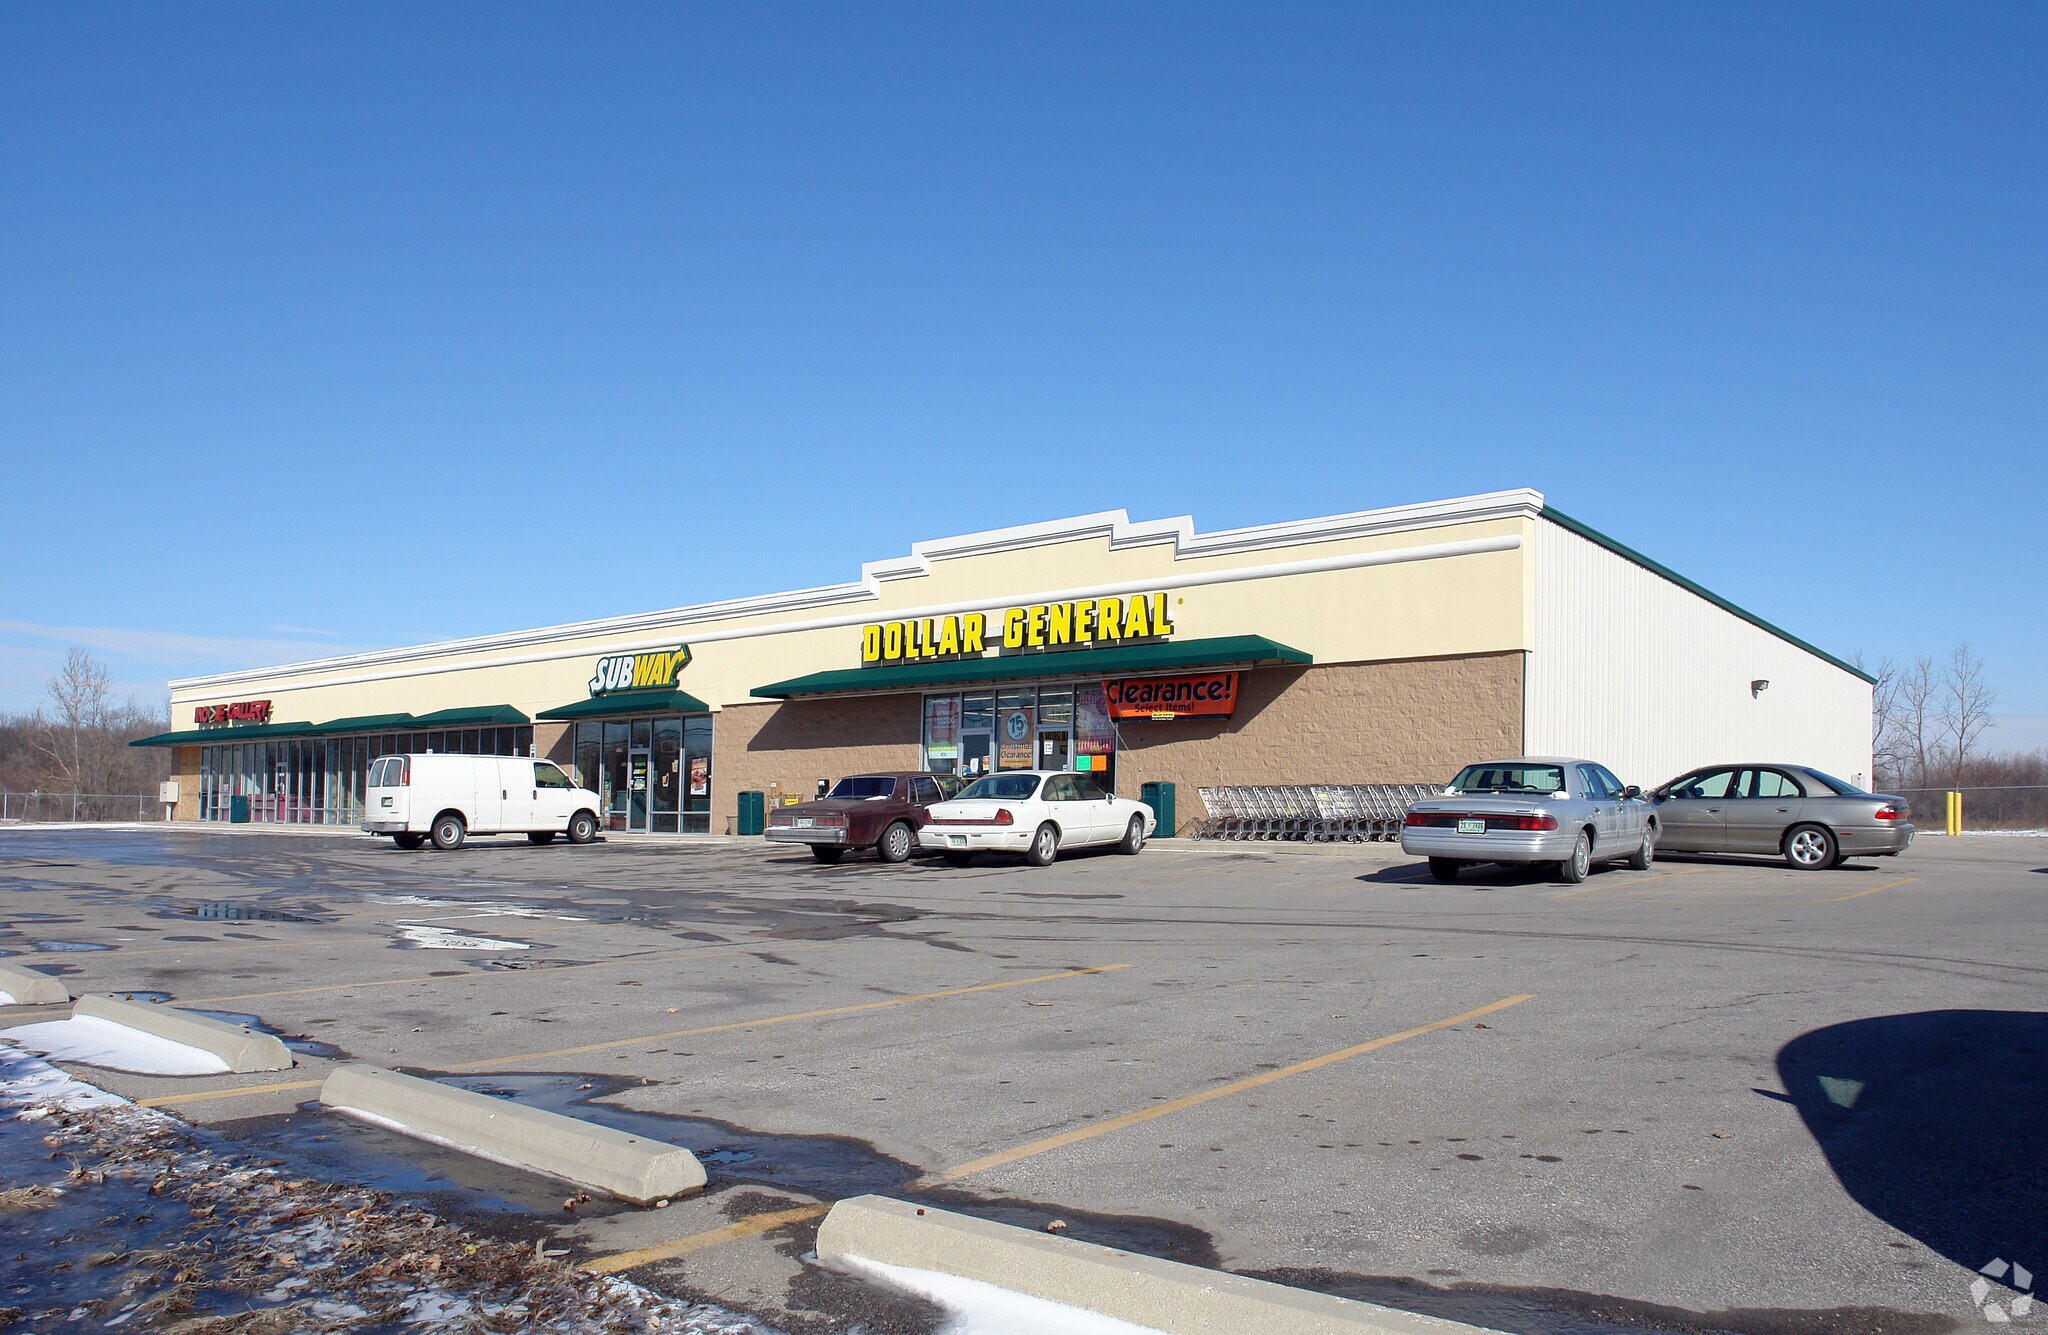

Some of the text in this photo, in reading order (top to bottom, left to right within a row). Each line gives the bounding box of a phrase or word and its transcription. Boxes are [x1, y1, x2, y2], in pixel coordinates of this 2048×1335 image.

[863, 592, 1171, 662] DOLLAR GENERAL
[589, 646, 688, 693] SUBWAY
[1106, 674, 1233, 705] Clearance!
[227, 700, 270, 722] GALLERY
[1135, 702, 1195, 713] Select Items!
